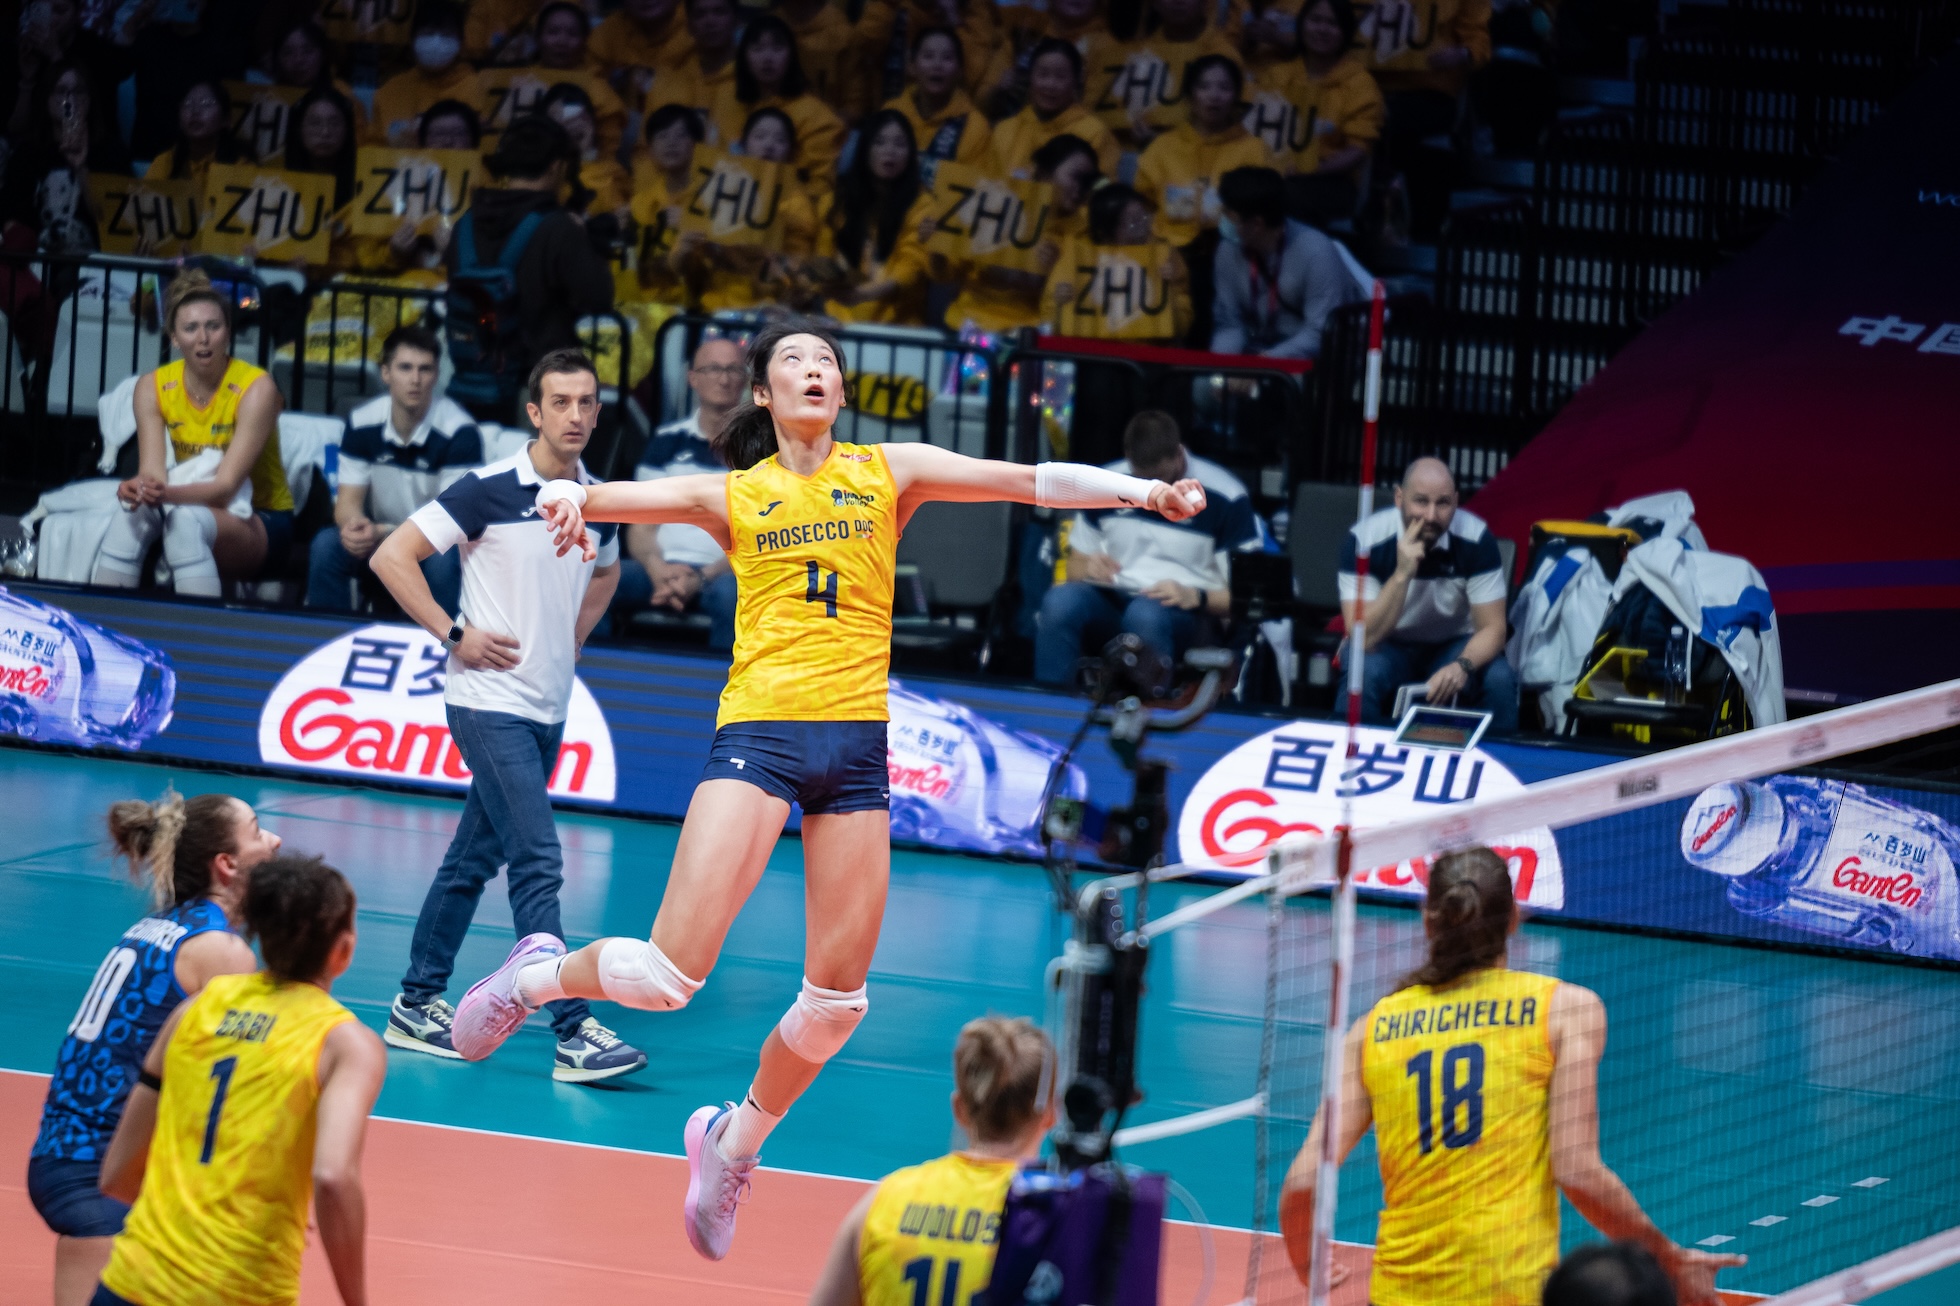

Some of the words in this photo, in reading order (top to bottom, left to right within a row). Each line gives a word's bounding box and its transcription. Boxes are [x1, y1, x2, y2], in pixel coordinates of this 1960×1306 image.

[1094, 62, 1191, 111] ZHU
[105, 190, 198, 241] ZHU
[215, 185, 325, 241] ZHU
[364, 168, 469, 216] ZHU
[689, 166, 782, 230] ZHU
[936, 184, 1050, 249] ZHU
[1074, 265, 1169, 316] ZHU
[756, 520, 850, 553] PROSECCO
[854, 519, 874, 533] DOC
[806, 560, 838, 618] 4
[340, 636, 449, 697] 百岁
[1263, 735, 1486, 805] 百岁山
[1885, 835, 1926, 863] 百岁山
[67, 946, 137, 1042] 10
[1374, 996, 1537, 1043] CHIRICHELLA
[199, 1055, 239, 1165] 1
[1407, 1042, 1485, 1155] 18
[900, 1203, 1001, 1244] WOLOS
